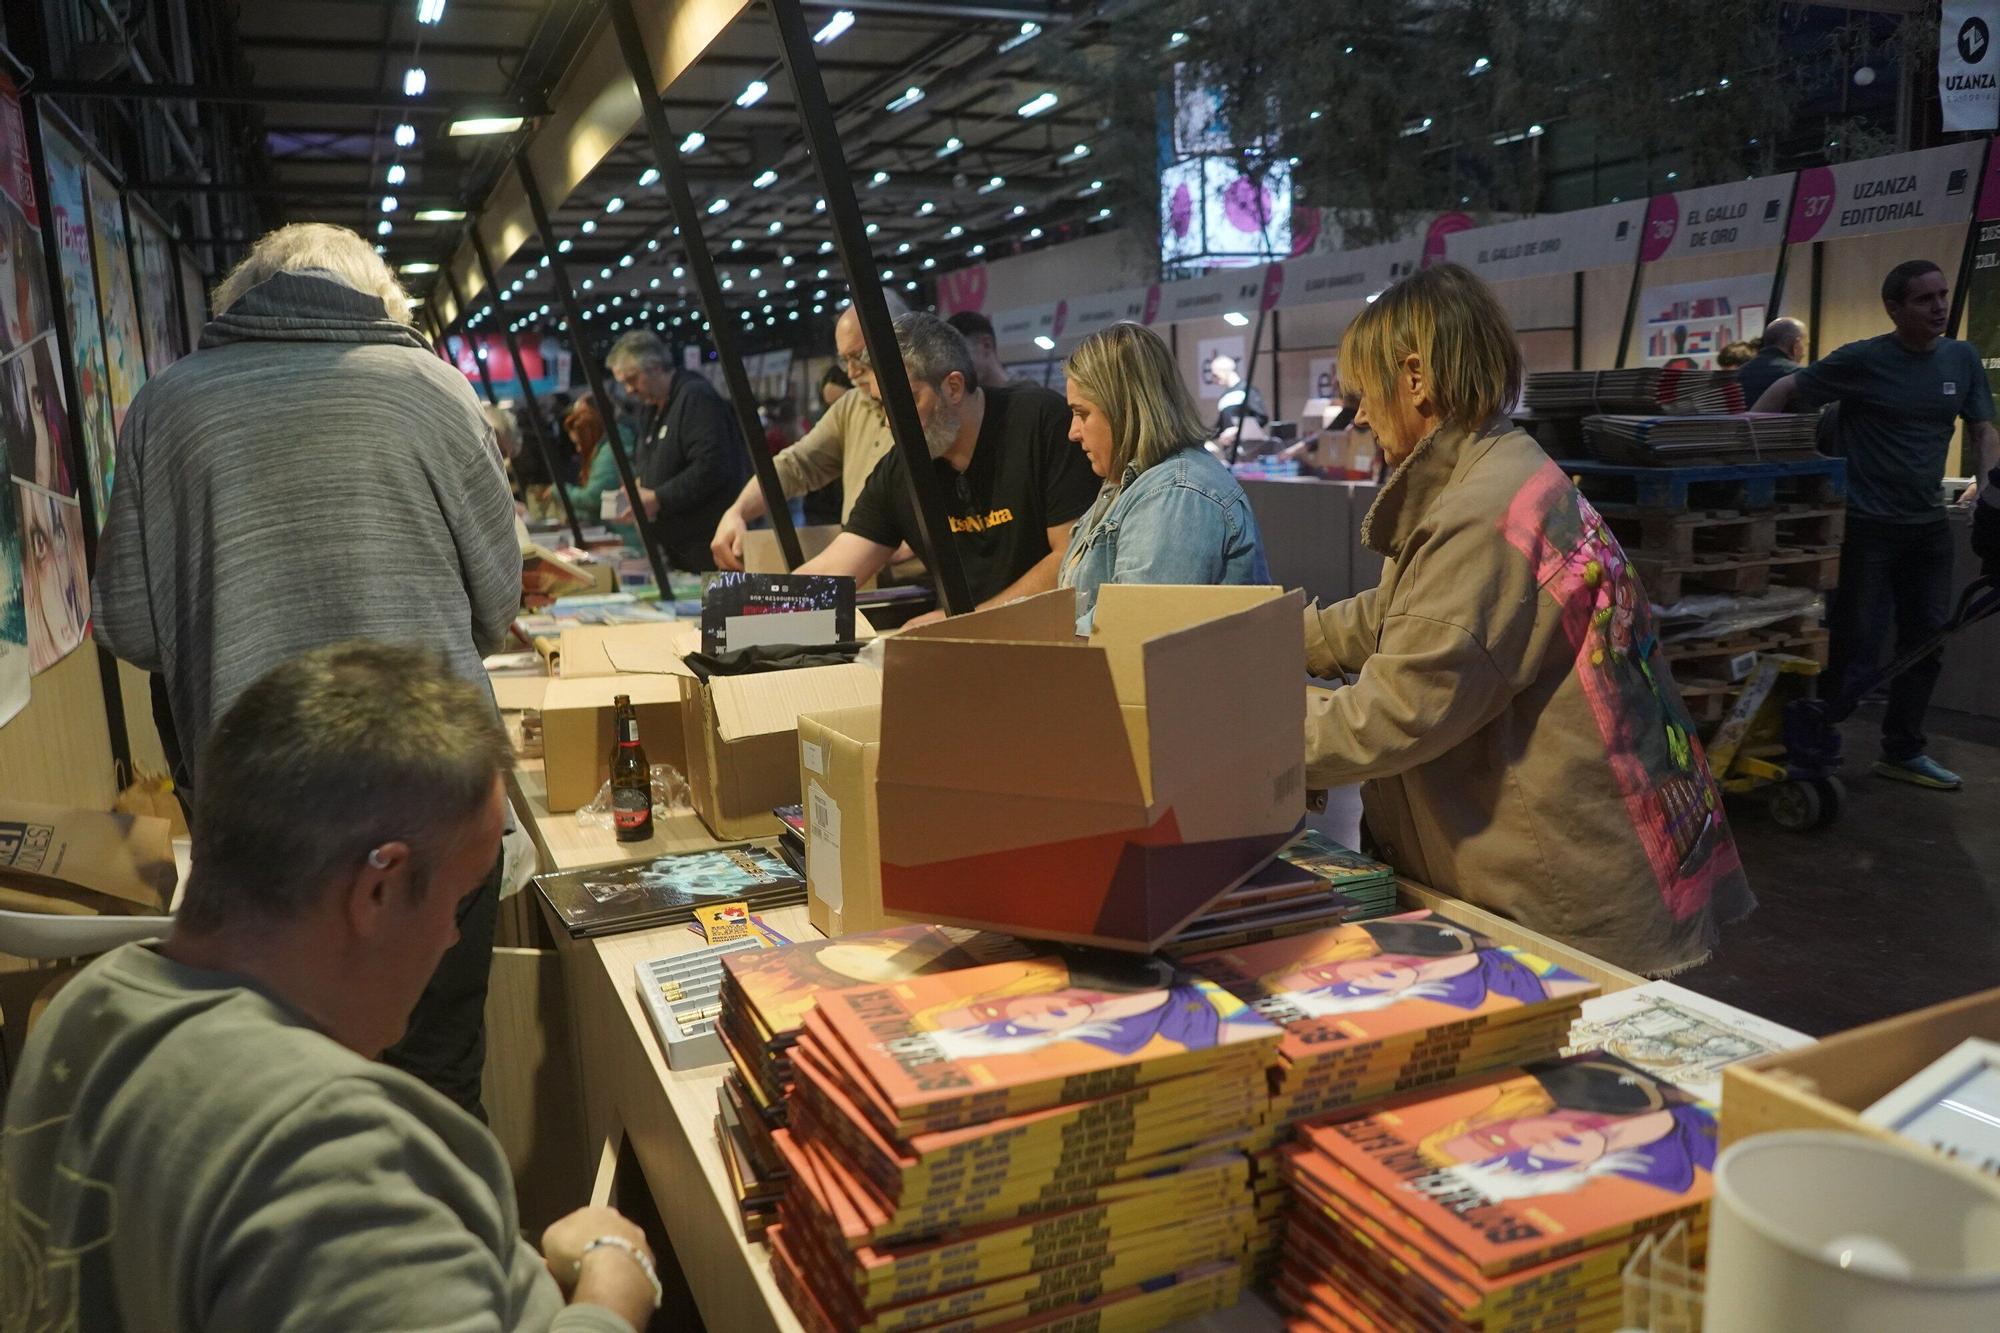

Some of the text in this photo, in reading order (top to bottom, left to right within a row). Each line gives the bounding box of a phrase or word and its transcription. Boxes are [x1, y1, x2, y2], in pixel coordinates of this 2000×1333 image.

[1945, 74, 1996, 91] UZANZA
[1853, 175, 1918, 200] UZANZA
[1687, 202, 1748, 226] EL GALLO
[1805, 195, 1830, 217] 37
[1840, 200, 1924, 227] EDITORIAL
[1689, 227, 1738, 248] DE ORO
